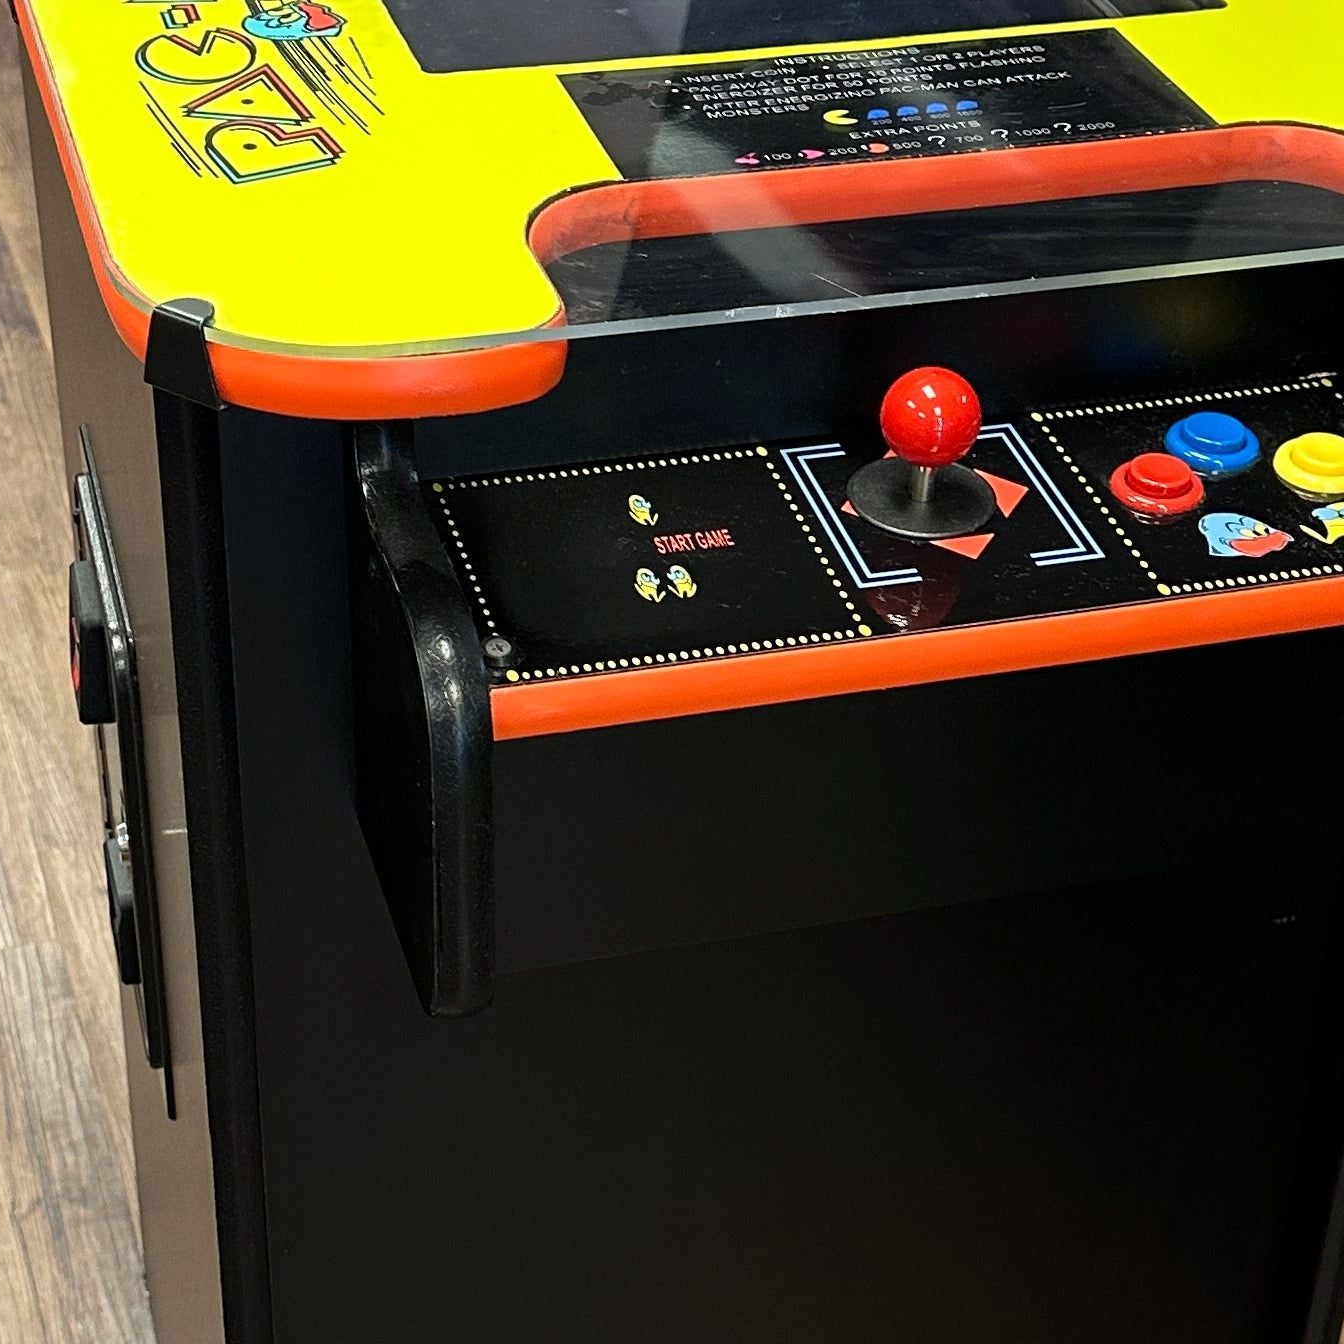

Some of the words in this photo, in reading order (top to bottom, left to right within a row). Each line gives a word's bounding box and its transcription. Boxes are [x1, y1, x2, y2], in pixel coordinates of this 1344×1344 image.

[774, 47, 921, 67] INSTRUCTIONS
[837, 58, 903, 70] SELECT
[910, 56, 918, 64] 1
[922, 53, 950, 62] OR
[954, 52, 964, 60] 2
[967, 45, 1046, 58] PLAYERS
[682, 72, 745, 84] INSERT
[750, 67, 796, 78] COIN
[688, 84, 725, 93] PAC
[729, 78, 778, 91] AWAY
[783, 75, 819, 86] DOT
[824, 71, 863, 81] FOR
[868, 69, 887, 77] 10
[891, 63, 956, 75] POINTS
[959, 55, 1046, 69] FLASHING
[693, 86, 797, 102] ENERGIZER
[801, 82, 838, 92] FOR
[868, 73, 933, 86] POINTS
[702, 100, 760, 111] AFTER
[765, 89, 876, 106] ENERGIZING
[880, 81, 959, 95] PAC-MAN
[963, 77, 1002, 87] CAN
[1006, 70, 1072, 84] ATTACK
[706, 104, 811, 119] MONSTERS
[763, 153, 793, 161] 100
[827, 146, 857, 157] 200
[954, 134, 984, 144] 700
[1014, 126, 1052, 138] 1000
[1076, 120, 1116, 132] 2000
[848, 127, 912, 140] EXTRA
[913, 119, 982, 134] POINTS
[653, 533, 696, 554] START
[694, 528, 736, 550] GAME
